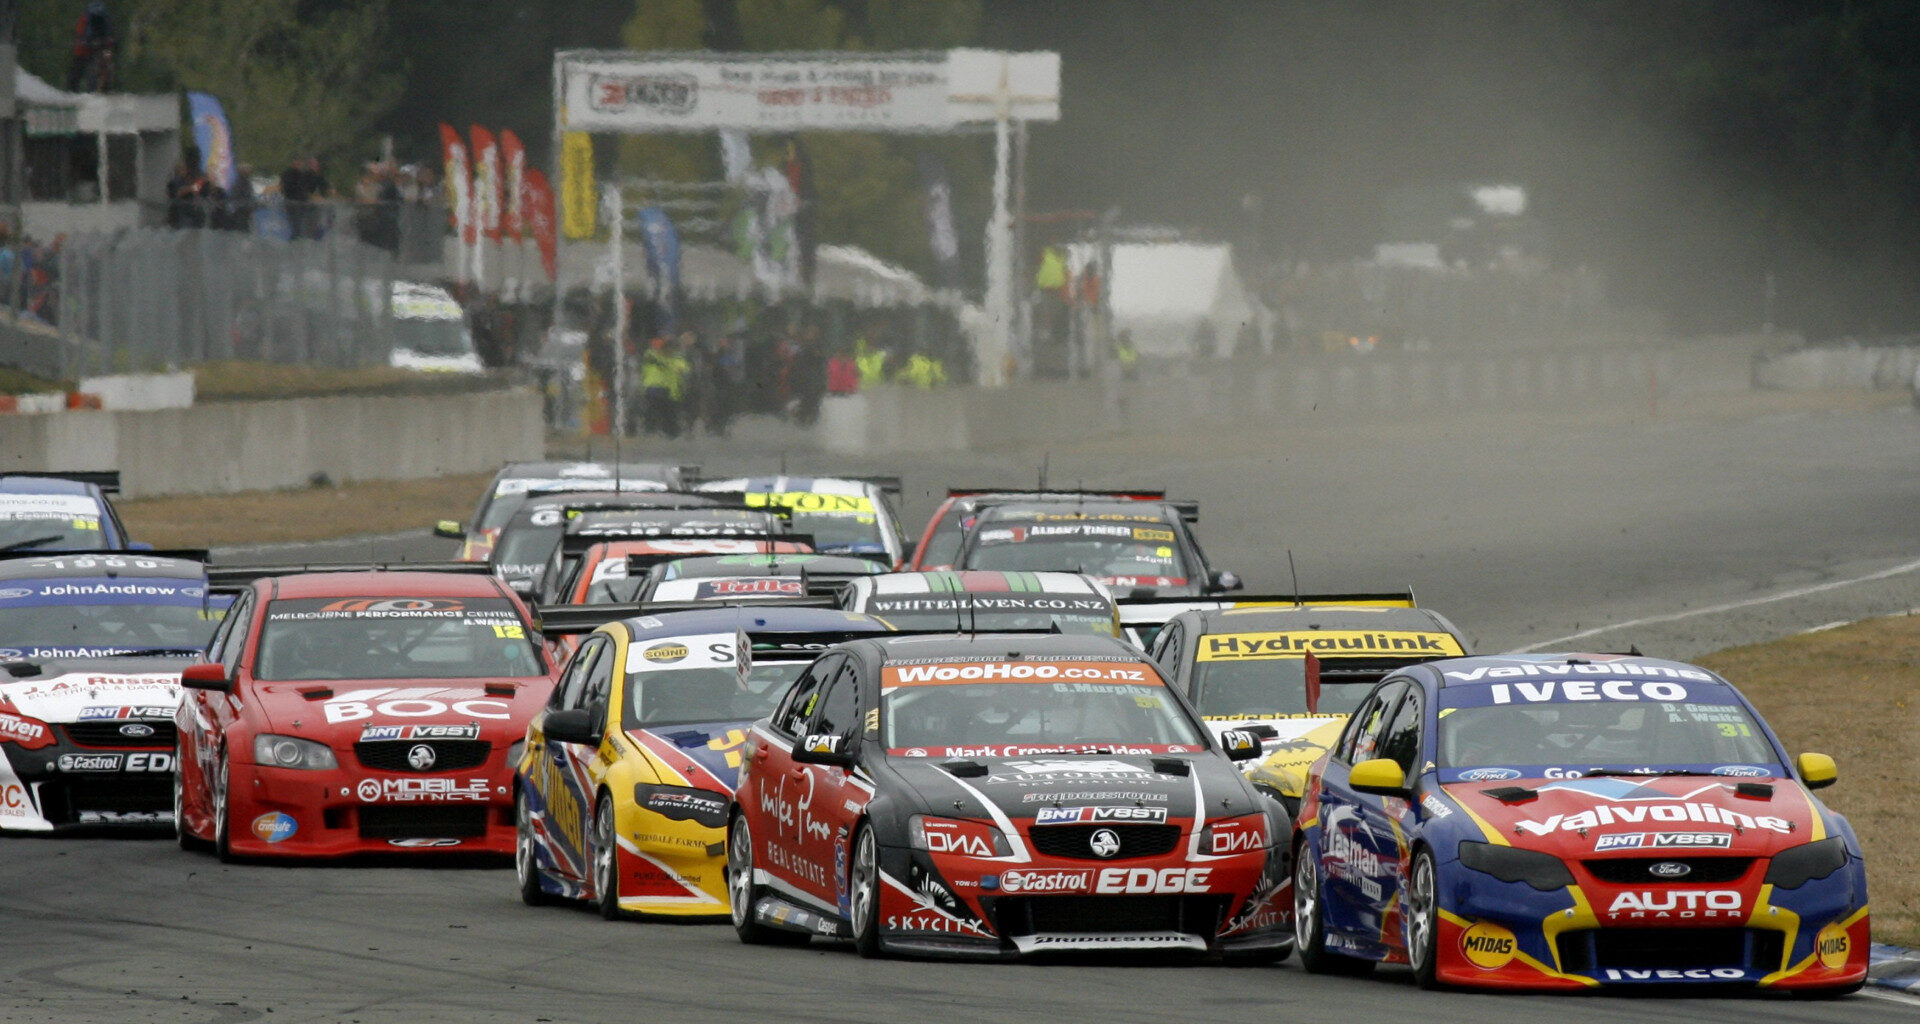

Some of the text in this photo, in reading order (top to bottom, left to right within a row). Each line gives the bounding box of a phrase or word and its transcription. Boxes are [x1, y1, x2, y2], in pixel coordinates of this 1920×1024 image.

[40, 584, 176, 596] JohnAndrew
[875, 598, 1105, 611] WHITEHAVEN.CO.NZ
[270, 609, 516, 620] MELBOURNE PERFORMANCE CENTRE
[492, 625, 525, 639] 12
[1209, 633, 1443, 653] Hydraulink
[645, 648, 689, 659] SOUND
[897, 663, 1145, 683] WooHoo.co.nz
[1490, 681, 1688, 704] IVECO
[79, 707, 117, 719] BNT
[323, 699, 511, 724] BOC
[1716, 723, 1752, 738] 31
[804, 734, 842, 754] CAT
[1227, 729, 1254, 750] CAT
[945, 746, 996, 758] Mark
[73, 753, 177, 772] Castrol ED
[1544, 767, 1583, 779] Go
[383, 779, 490, 793] MOBILE
[648, 800, 721, 814] signwriters
[1037, 807, 1163, 821] BNT V8ST
[676, 837, 707, 848] FARMS
[1599, 833, 1728, 847] BNT V8ST
[767, 842, 826, 888] REAL ESTATE
[1022, 867, 1213, 894] Castrol EDGE
[1608, 890, 1743, 912] AUTO
[1228, 910, 1290, 930] SKYCITY
[1607, 910, 1742, 919] TRADER
[888, 915, 983, 933] SKYCITY
[1464, 935, 1513, 955] MIDAS
[1817, 935, 1847, 956] MIDAS
[1605, 968, 1745, 981] IVECO
